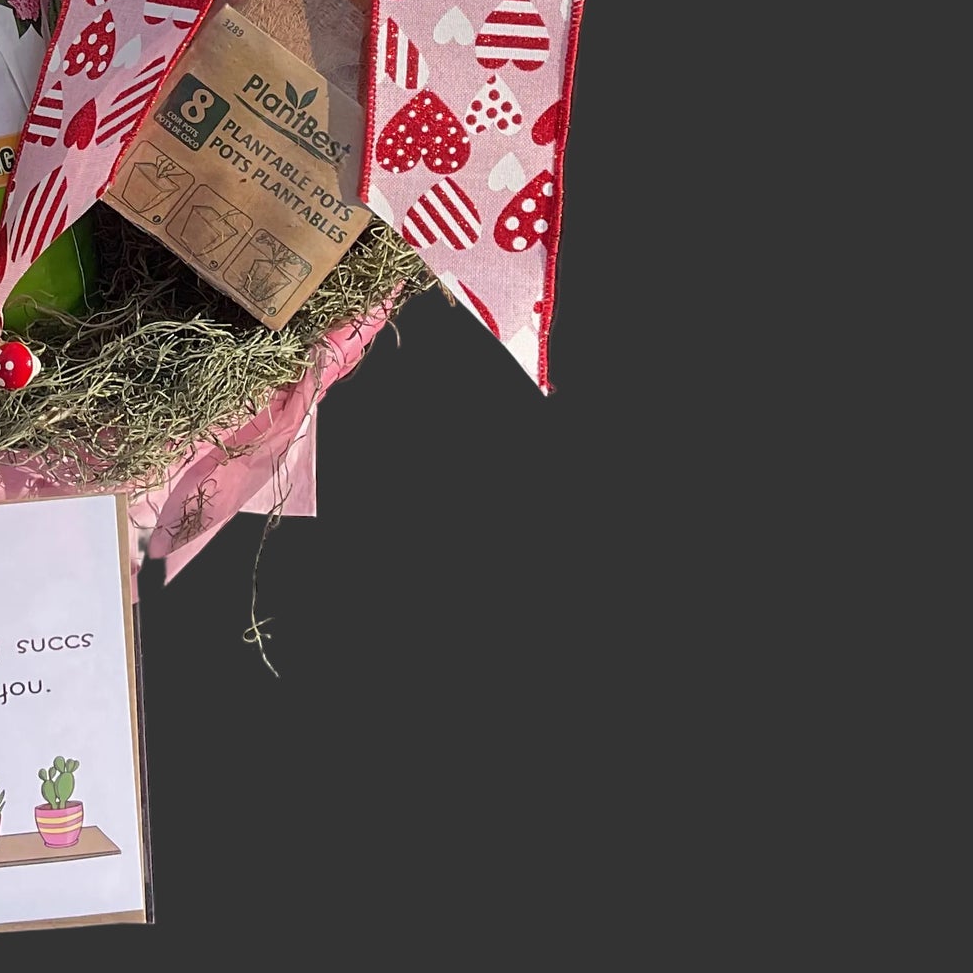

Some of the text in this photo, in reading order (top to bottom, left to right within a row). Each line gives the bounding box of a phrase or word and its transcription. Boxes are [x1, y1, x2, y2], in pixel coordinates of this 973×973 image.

[222, 18, 245, 38] 3289
[180, 88, 215, 124] 8
[242, 74, 352, 165] PlantBest
[155, 114, 200, 149] POTS DE COCO
[167, 110, 199, 138] COIR POTS
[223, 118, 354, 223] PLANTABLE POTS
[208, 137, 348, 246] POTS PLANTABLES
[17, 631, 94, 655] succs
